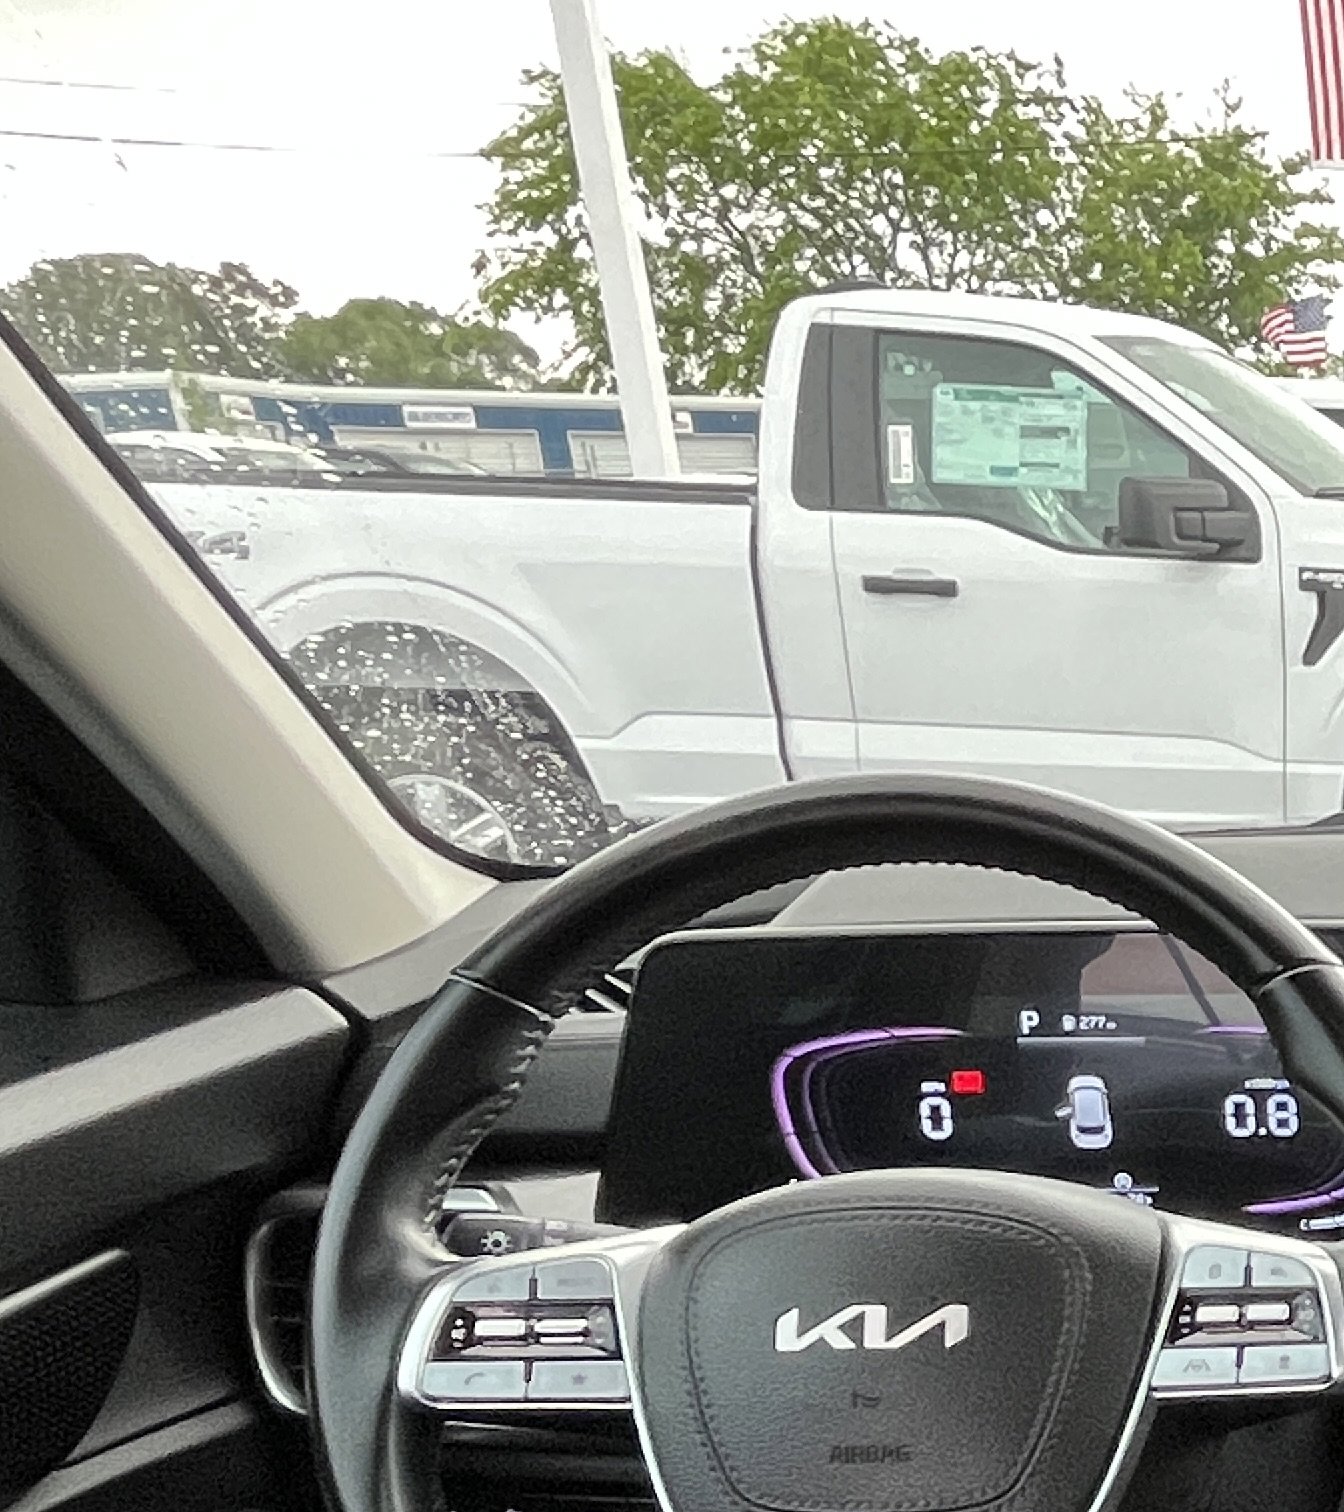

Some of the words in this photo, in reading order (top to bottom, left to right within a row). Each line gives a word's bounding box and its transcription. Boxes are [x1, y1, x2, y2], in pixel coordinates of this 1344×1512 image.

[1020, 1010, 1040, 1035] P
[1079, 1015, 1106, 1030] 277
[919, 1096, 954, 1141] 0
[1223, 1093, 1299, 1138] 0.8
[774, 1303, 969, 1351] KIA
